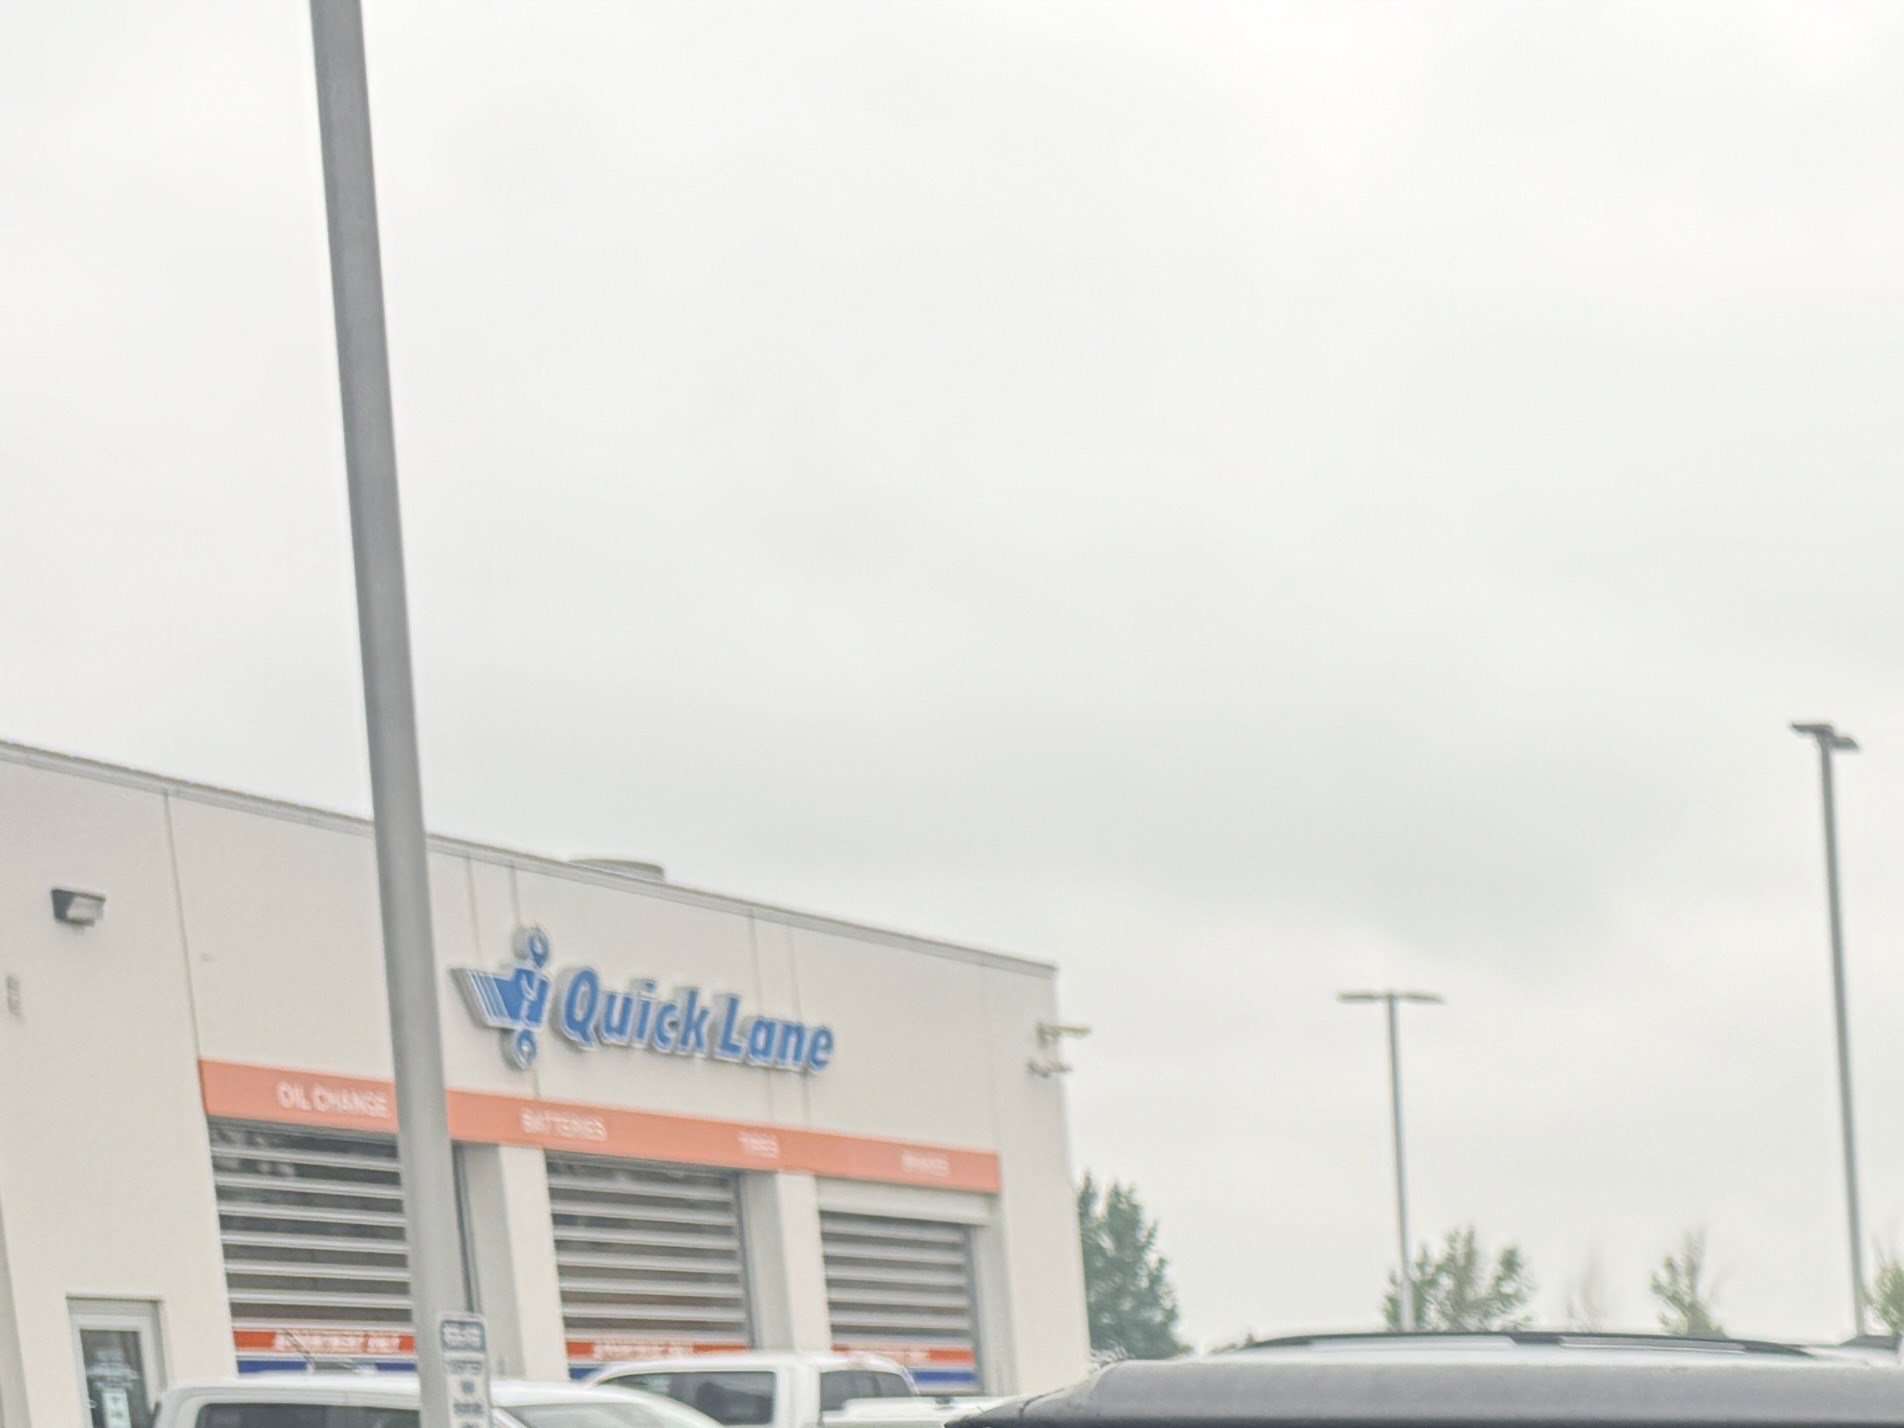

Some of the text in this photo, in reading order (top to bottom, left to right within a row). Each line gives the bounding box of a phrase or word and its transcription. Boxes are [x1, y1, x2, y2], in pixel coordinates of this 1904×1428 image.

[557, 966, 835, 1073] Quick Lane
[276, 1081, 311, 1111] OIL
